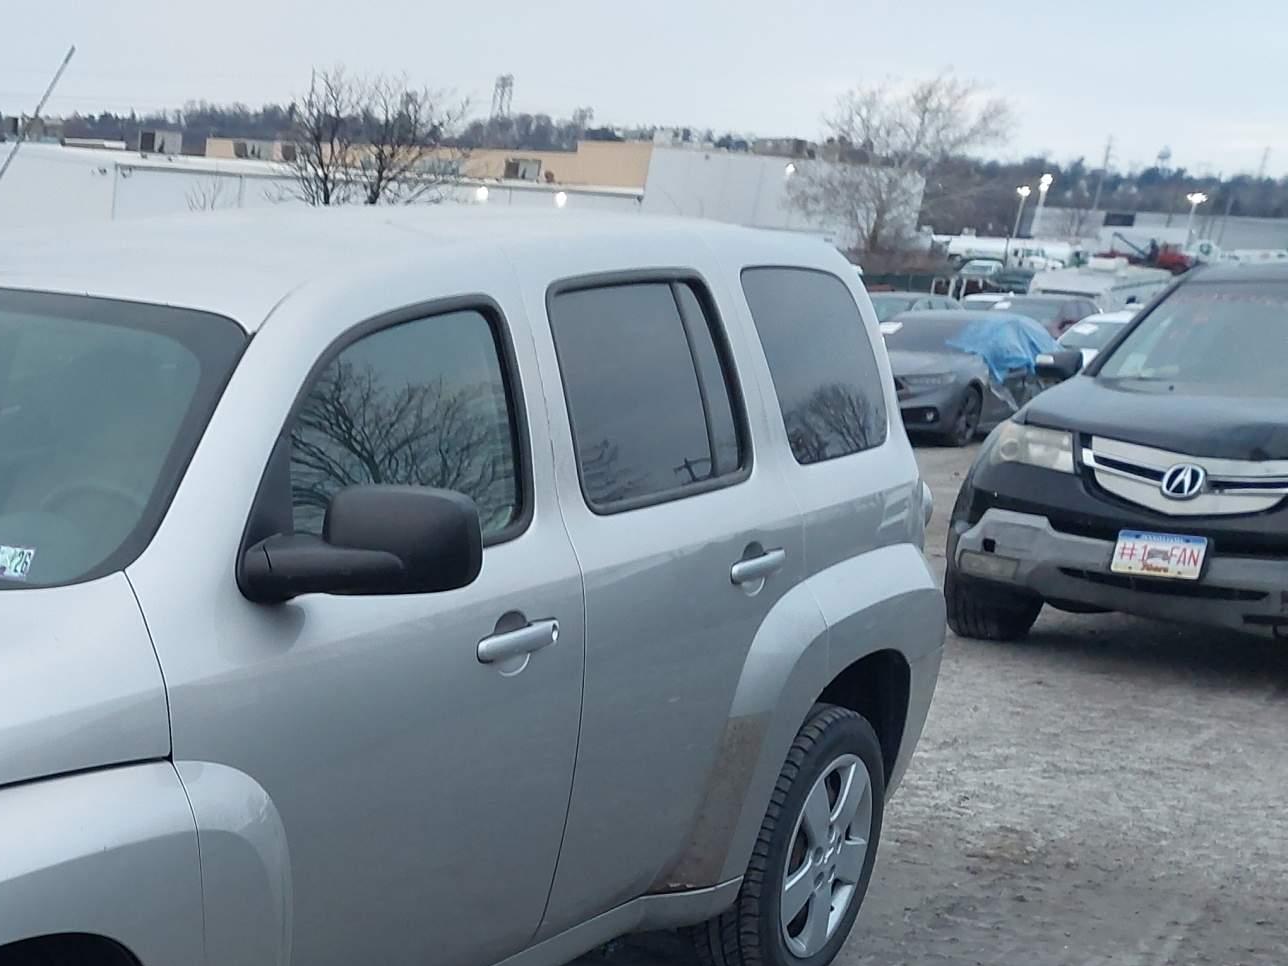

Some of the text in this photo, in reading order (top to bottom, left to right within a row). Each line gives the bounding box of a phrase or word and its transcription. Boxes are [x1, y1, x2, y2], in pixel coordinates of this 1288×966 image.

[13, 550, 32, 574] 26
[1119, 542, 1201, 567] #1 FAN
